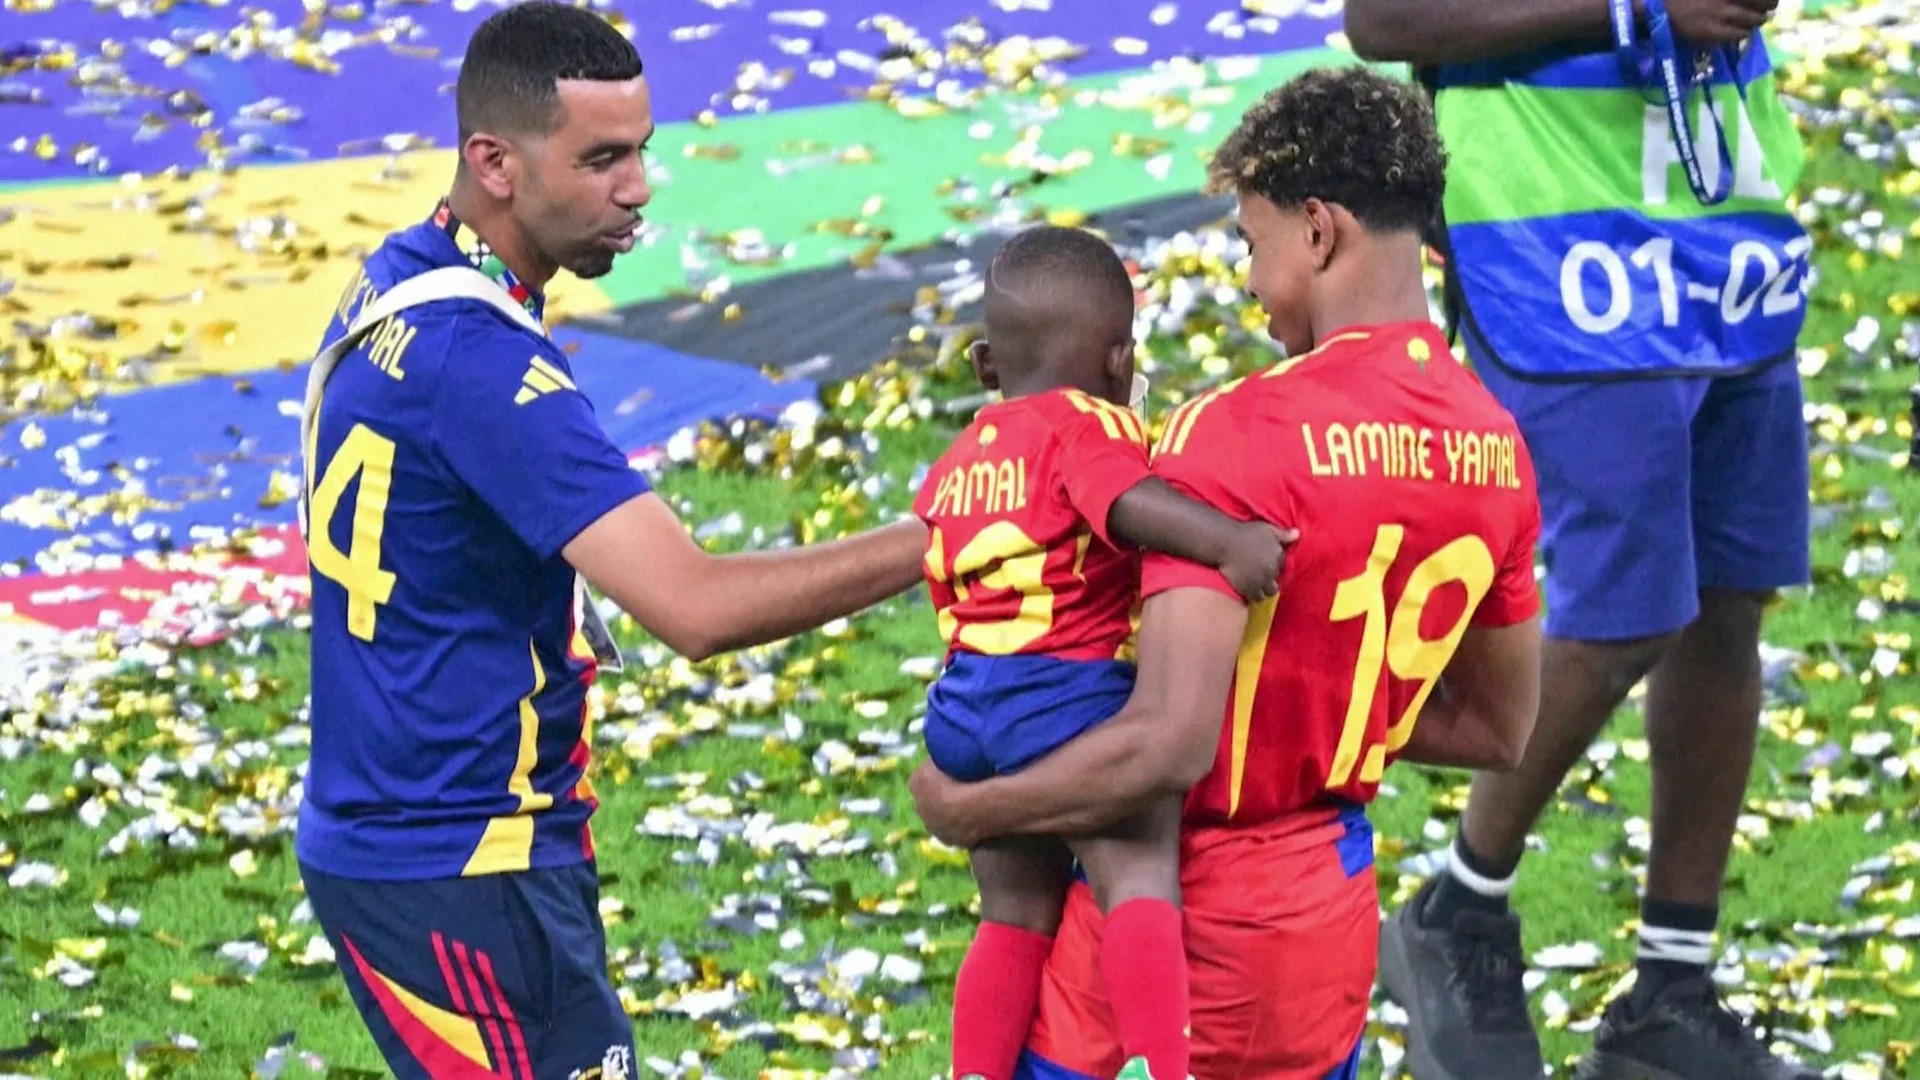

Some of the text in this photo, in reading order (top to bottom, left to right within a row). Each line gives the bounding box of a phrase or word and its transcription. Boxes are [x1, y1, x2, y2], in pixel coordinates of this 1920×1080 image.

[927, 456, 1027, 518] YAMAL
[1302, 421, 1521, 489] LAMINE YAMAL
[1325, 523, 1495, 789] 19
